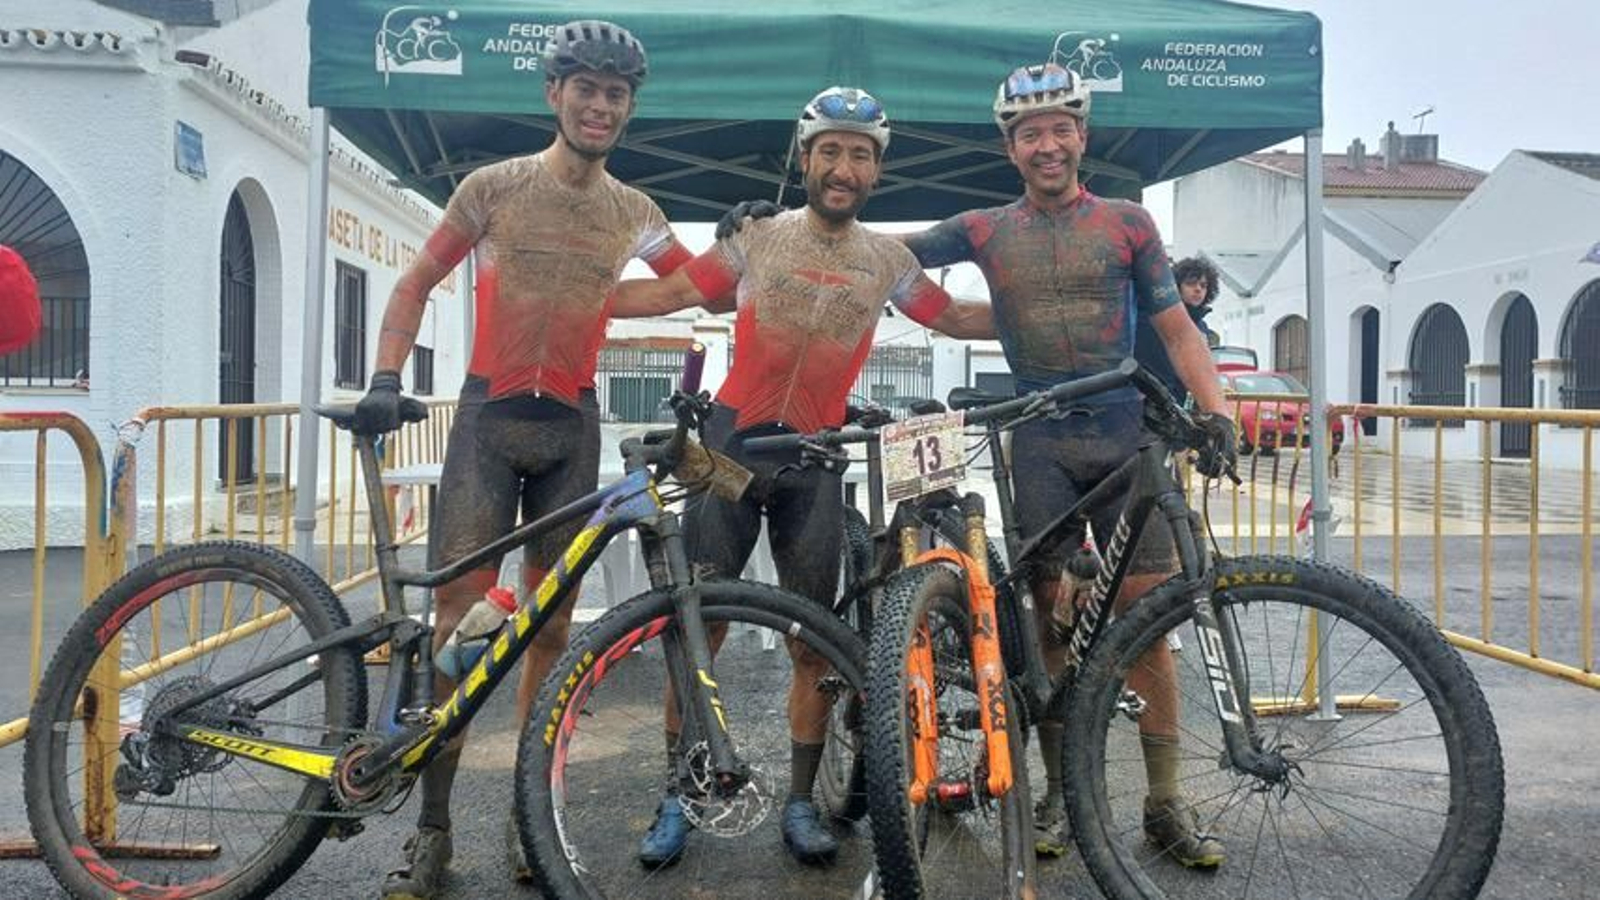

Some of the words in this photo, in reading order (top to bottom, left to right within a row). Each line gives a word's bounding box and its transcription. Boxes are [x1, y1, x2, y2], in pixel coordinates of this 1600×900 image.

[508, 23, 556, 38] FEDE
[482, 38, 546, 55] ANDAL
[1165, 43, 1264, 57] FEDERACION
[513, 57, 538, 71] DE
[1141, 58, 1227, 72] ANDALUZA
[1167, 74, 1189, 87] DE
[1192, 75, 1266, 87] CICLISMO
[329, 205, 365, 254] ASETA
[912, 435, 942, 475] 13
[1216, 571, 1295, 589] AXXIS
[194, 730, 277, 757] SCOTT
